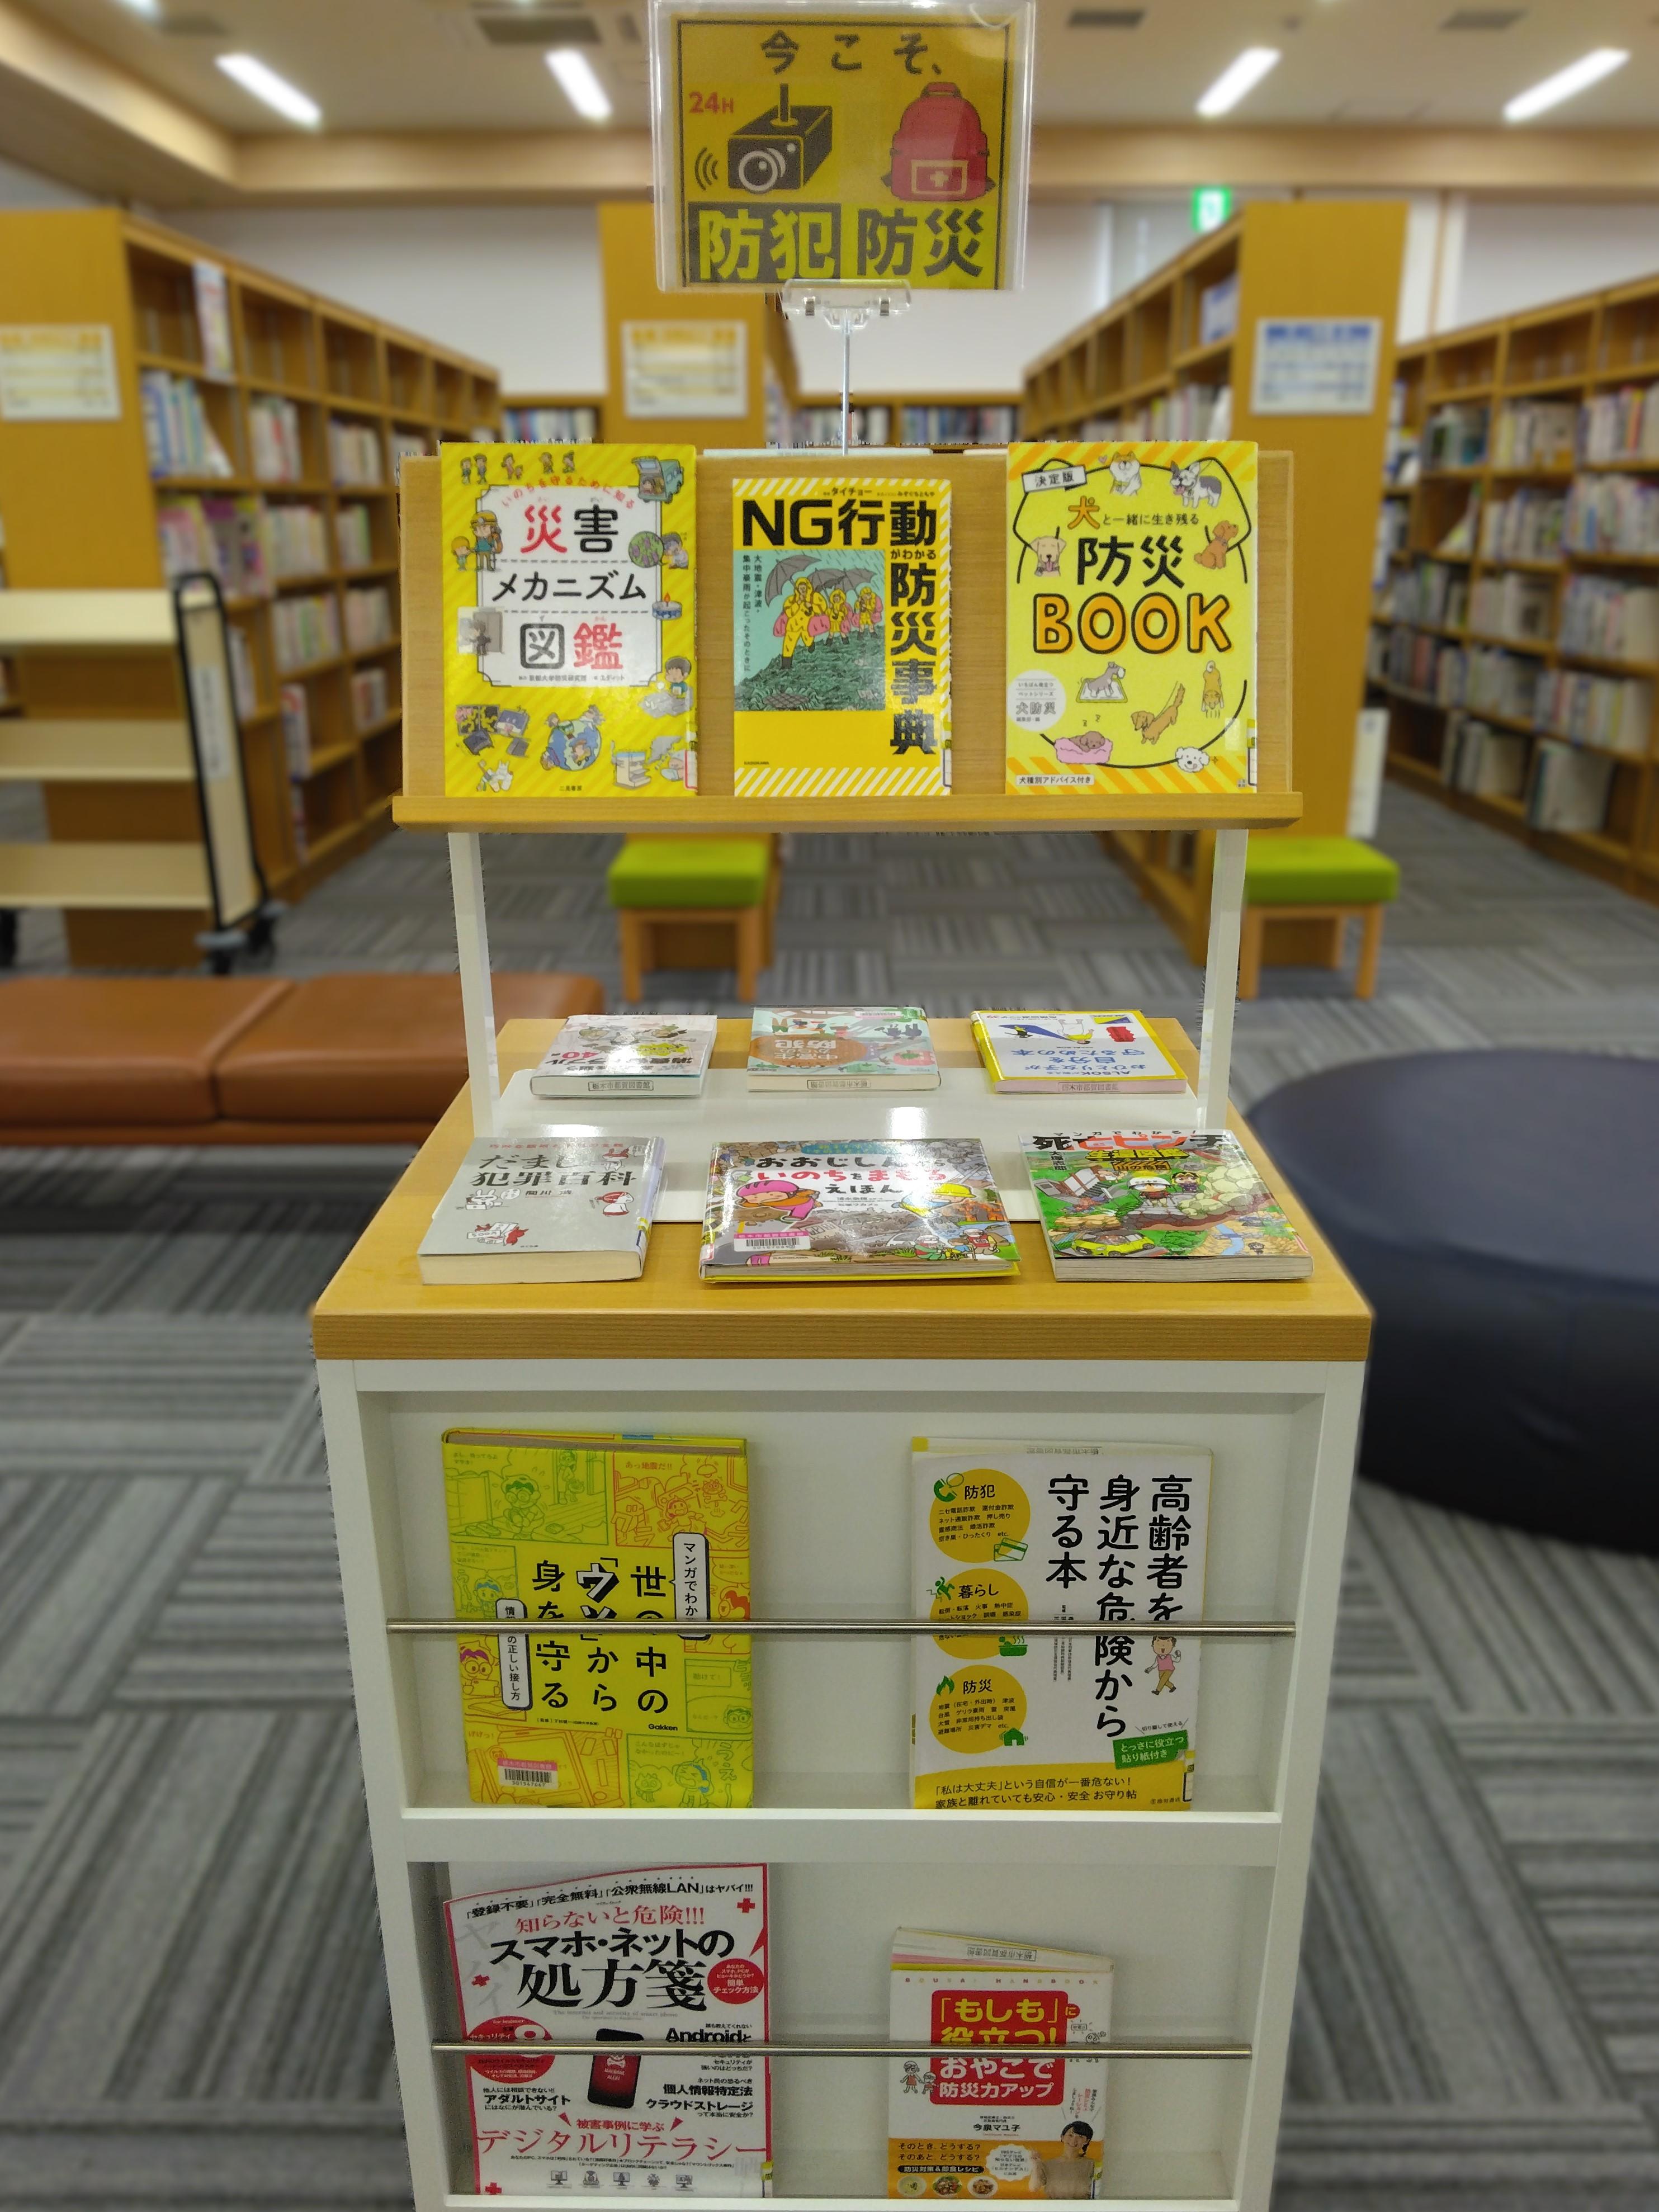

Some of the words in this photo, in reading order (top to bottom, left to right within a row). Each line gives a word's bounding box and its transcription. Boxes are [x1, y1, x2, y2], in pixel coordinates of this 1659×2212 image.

[761, 30, 942, 75] 今こそ、
[689, 91, 734, 114] 24H
[699, 210, 835, 280] 防犯
[857, 207, 984, 277] 防災
[1036, 471, 1074, 488] 決定版
[1067, 495, 1199, 529] 犬と一緒に生き残る
[521, 504, 618, 553] 災害
[742, 499, 937, 547] NG行動
[891, 549, 936, 560] がわかる
[1077, 535, 1184, 588] 防災
[491, 570, 646, 602] メカニズム
[1033, 592, 1233, 655] BOOK
[521, 622, 623, 669] 図鑑
[890, 563, 938, 755] 防災事典
[1016, 702, 1056, 715] 犬防災
[775, 1039, 836, 1049] 防犯
[774, 1052, 838, 1060] 中高生
[1033, 1134, 1232, 1150] 死亡ピンチ
[470, 1171, 637, 1187] 犯罪百科
[825, 1184, 903, 1194] えほん
[965, 1485, 995, 1500] 防犯
[939, 1506, 976, 1515] ニセ電話詐欺
[939, 1515, 980, 1524] ネット通販詐欺
[939, 1532, 991, 1542] 空き巣・ひったくり
[1046, 1474, 1089, 1589] 守る本
[1147, 1474, 1193, 1621] 高齢者を
[683, 1543, 698, 1620] マンガでわか
[958, 1584, 999, 1599] 暮らし
[1094, 1474, 1140, 1737] 身近な危険から
[505, 1606, 520, 1701] 情の正しい接し方
[963, 1679, 992, 1694] 防災
[956, 1707, 984, 1715] ゲリラ豪雨
[956, 1715, 1004, 1723] 非常用持ち出し袋
[938, 1726, 962, 1735] 避難場所
[1142, 1721, 1183, 1732] 切り離して使える
[1121, 1736, 1184, 1752] とっさに役立つ
[1122, 1749, 1168, 1764] 貼り紙付き
[935, 1790, 1090, 1809] 家族と離れていても安心・安全
[1093, 1789, 1137, 1800] お守り帖
[516, 1904, 704, 1934] 知らないと危険!!!
[490, 1929, 735, 1965] スマホ・ネットの
[517, 1959, 707, 2011] 処方箋
[940, 2057, 1056, 2080] おやこで
[663, 2084, 753, 2096] 個人情報特定法
[939, 2082, 1055, 2100] 防災力アップ
[484, 2094, 571, 2106] アダルトサイト
[646, 2098, 753, 2111] クラウドストレージ
[576, 2119, 664, 2131] 被害事例に学ぶ
[478, 2129, 766, 2161] デジタルリテラシー
